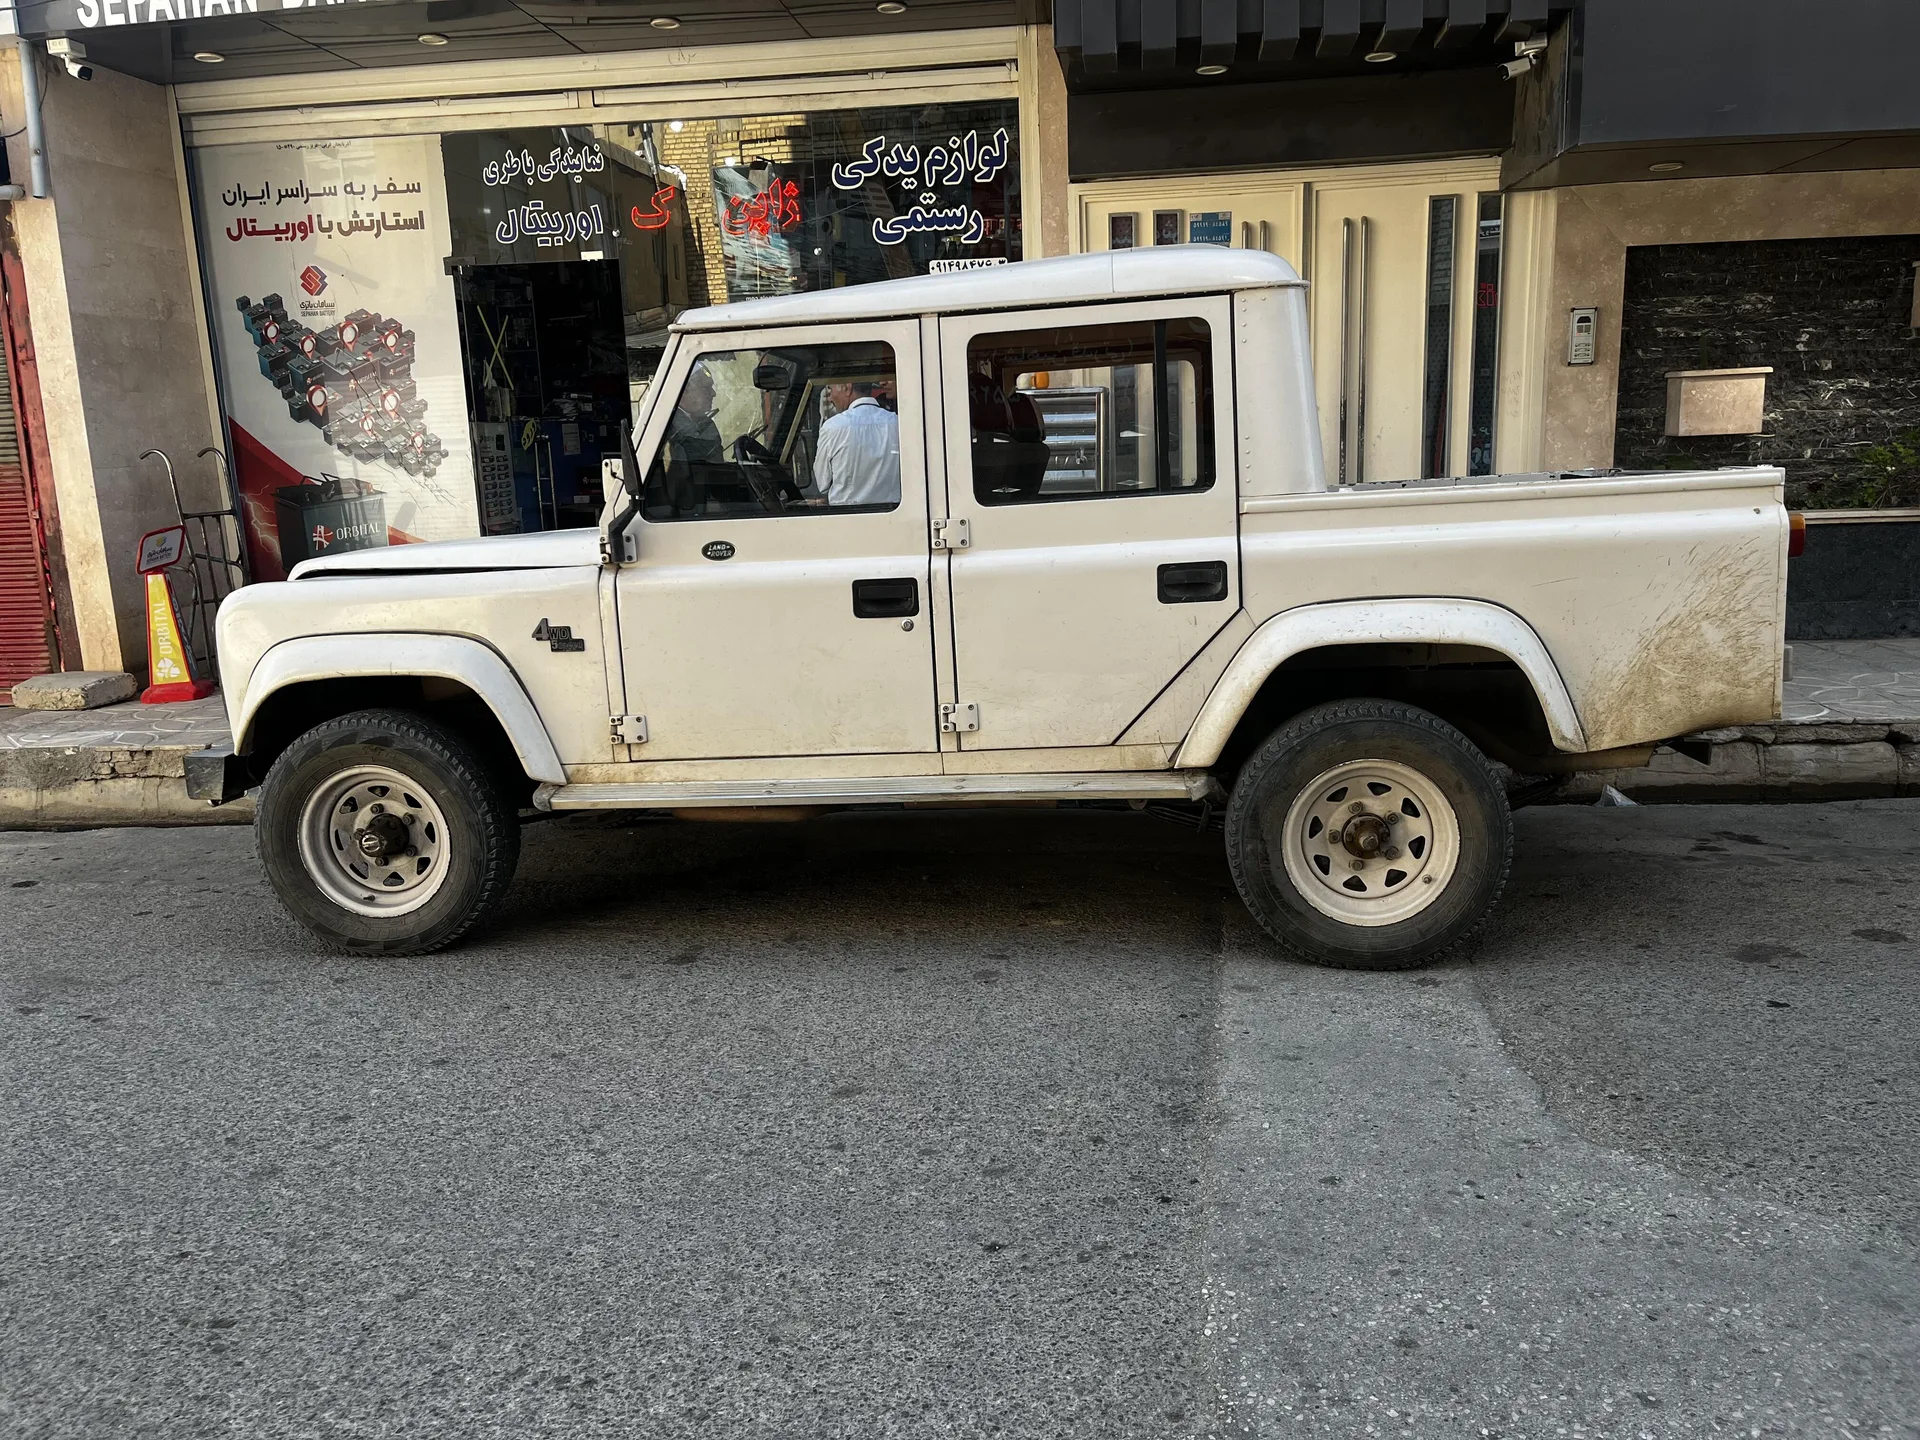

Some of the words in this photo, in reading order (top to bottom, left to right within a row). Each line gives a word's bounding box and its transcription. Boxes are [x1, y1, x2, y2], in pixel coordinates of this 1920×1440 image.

[483, 149, 535, 186] باطری
[537, 144, 604, 183] نمایندگی
[832, 136, 920, 190] یدکی
[924, 128, 1009, 187] لوازم
[222, 181, 270, 207] ایران
[276, 179, 337, 205] سراسر
[343, 180, 366, 200] به
[371, 177, 421, 201] سفر
[226, 214, 314, 242] اوربیتال
[317, 214, 333, 239] با
[337, 210, 425, 239] استارتش
[496, 200, 604, 247] اوربیتال
[872, 192, 984, 245] رستمی
[336, 522, 381, 540] ORBITAL
[153, 600, 173, 654] ORBITAL
